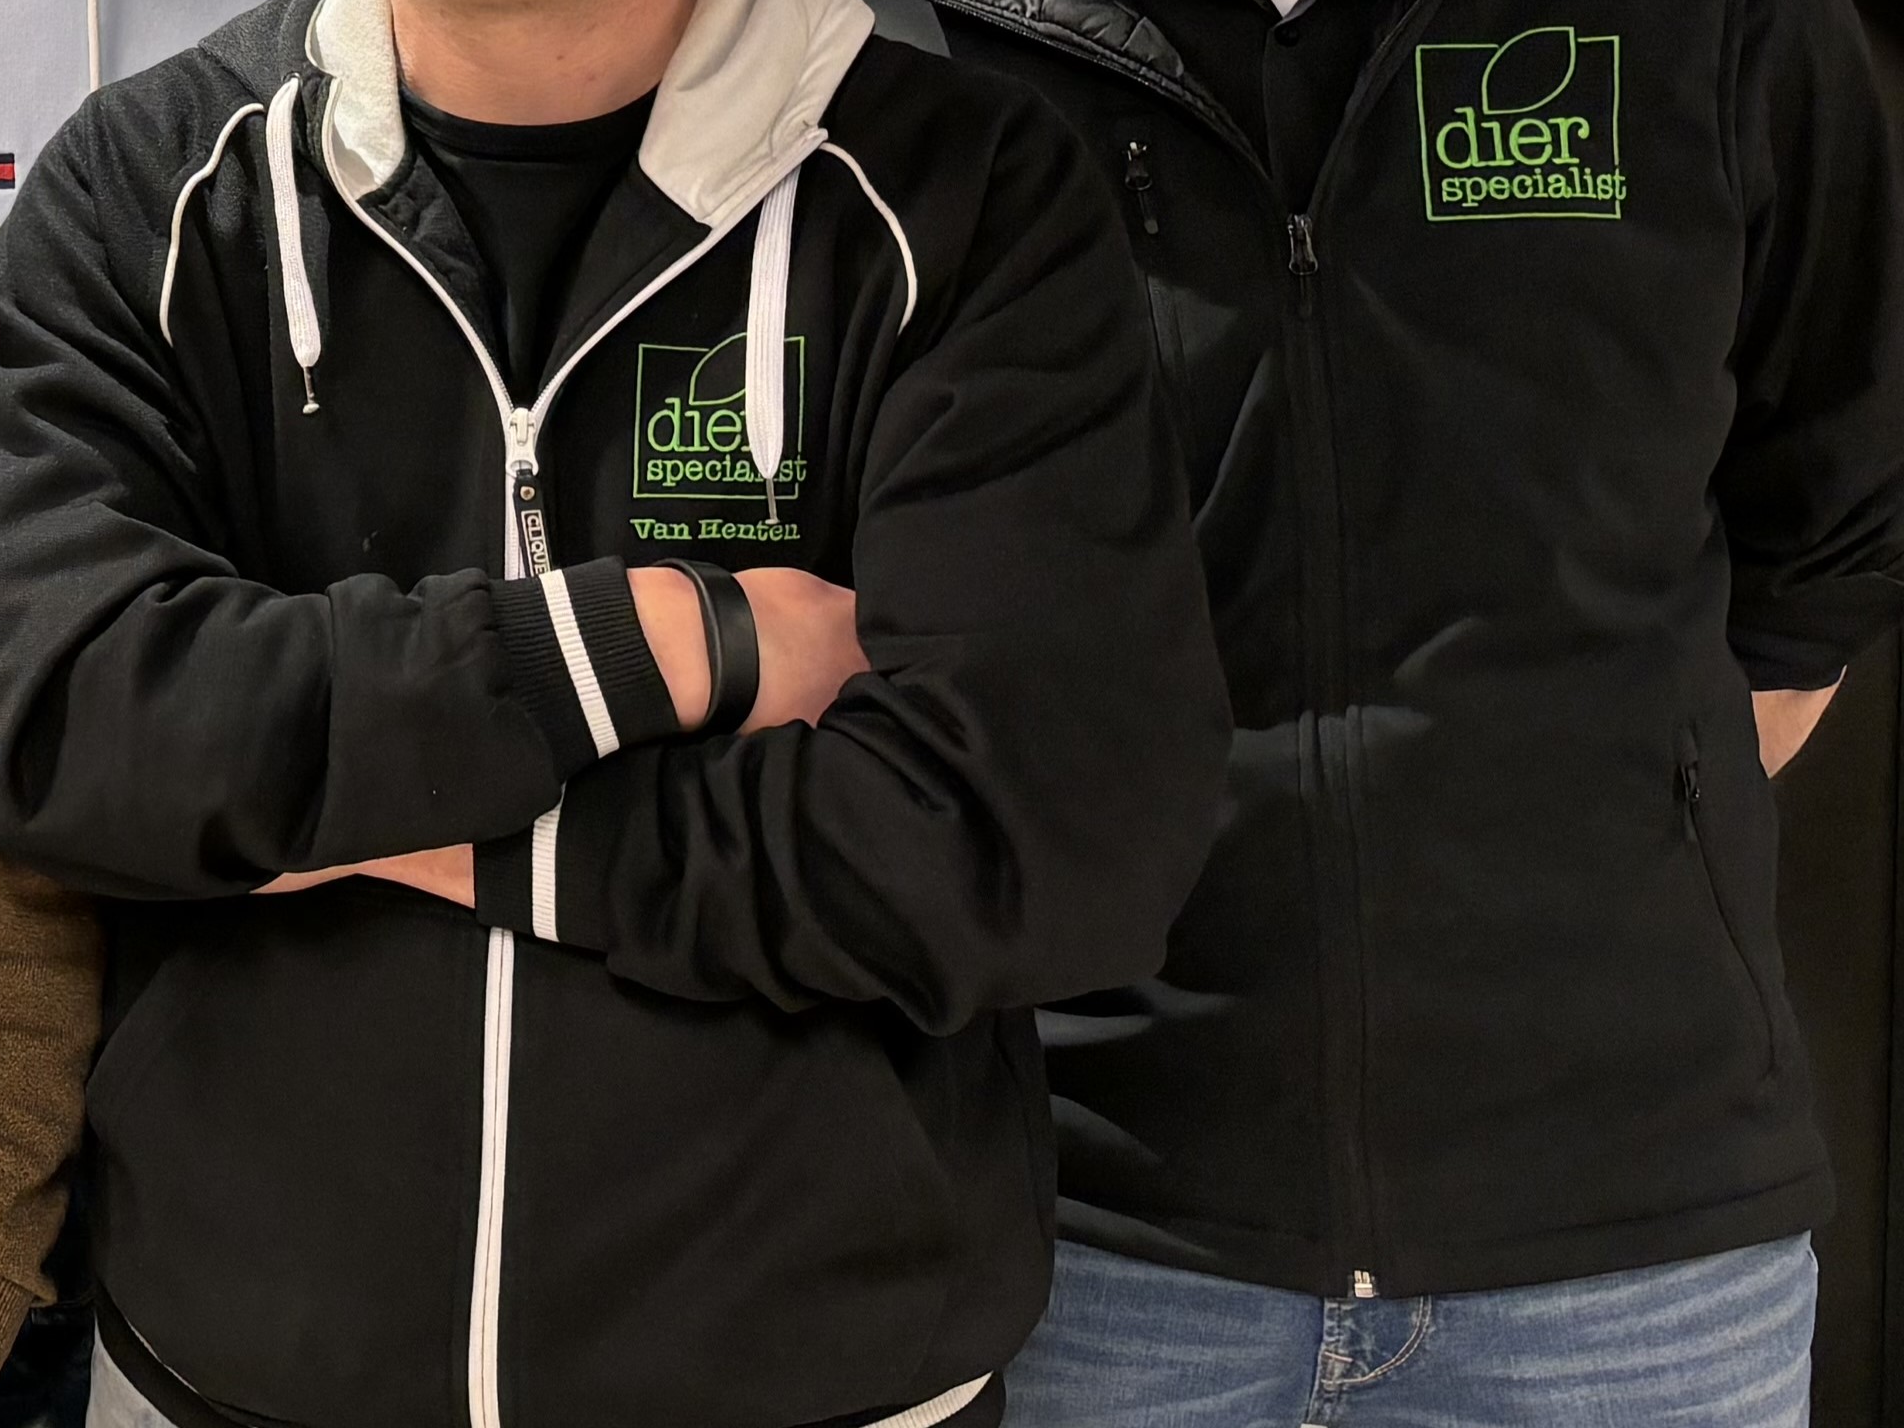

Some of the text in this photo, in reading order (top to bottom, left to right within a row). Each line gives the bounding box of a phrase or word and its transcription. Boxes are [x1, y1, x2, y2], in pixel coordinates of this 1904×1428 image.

[1436, 106, 1590, 169] dier
[1442, 166, 1627, 207] specialist
[647, 397, 752, 452] die
[647, 454, 808, 486] speciast
[527, 514, 547, 575] CLIQUE
[629, 518, 693, 540] Van
